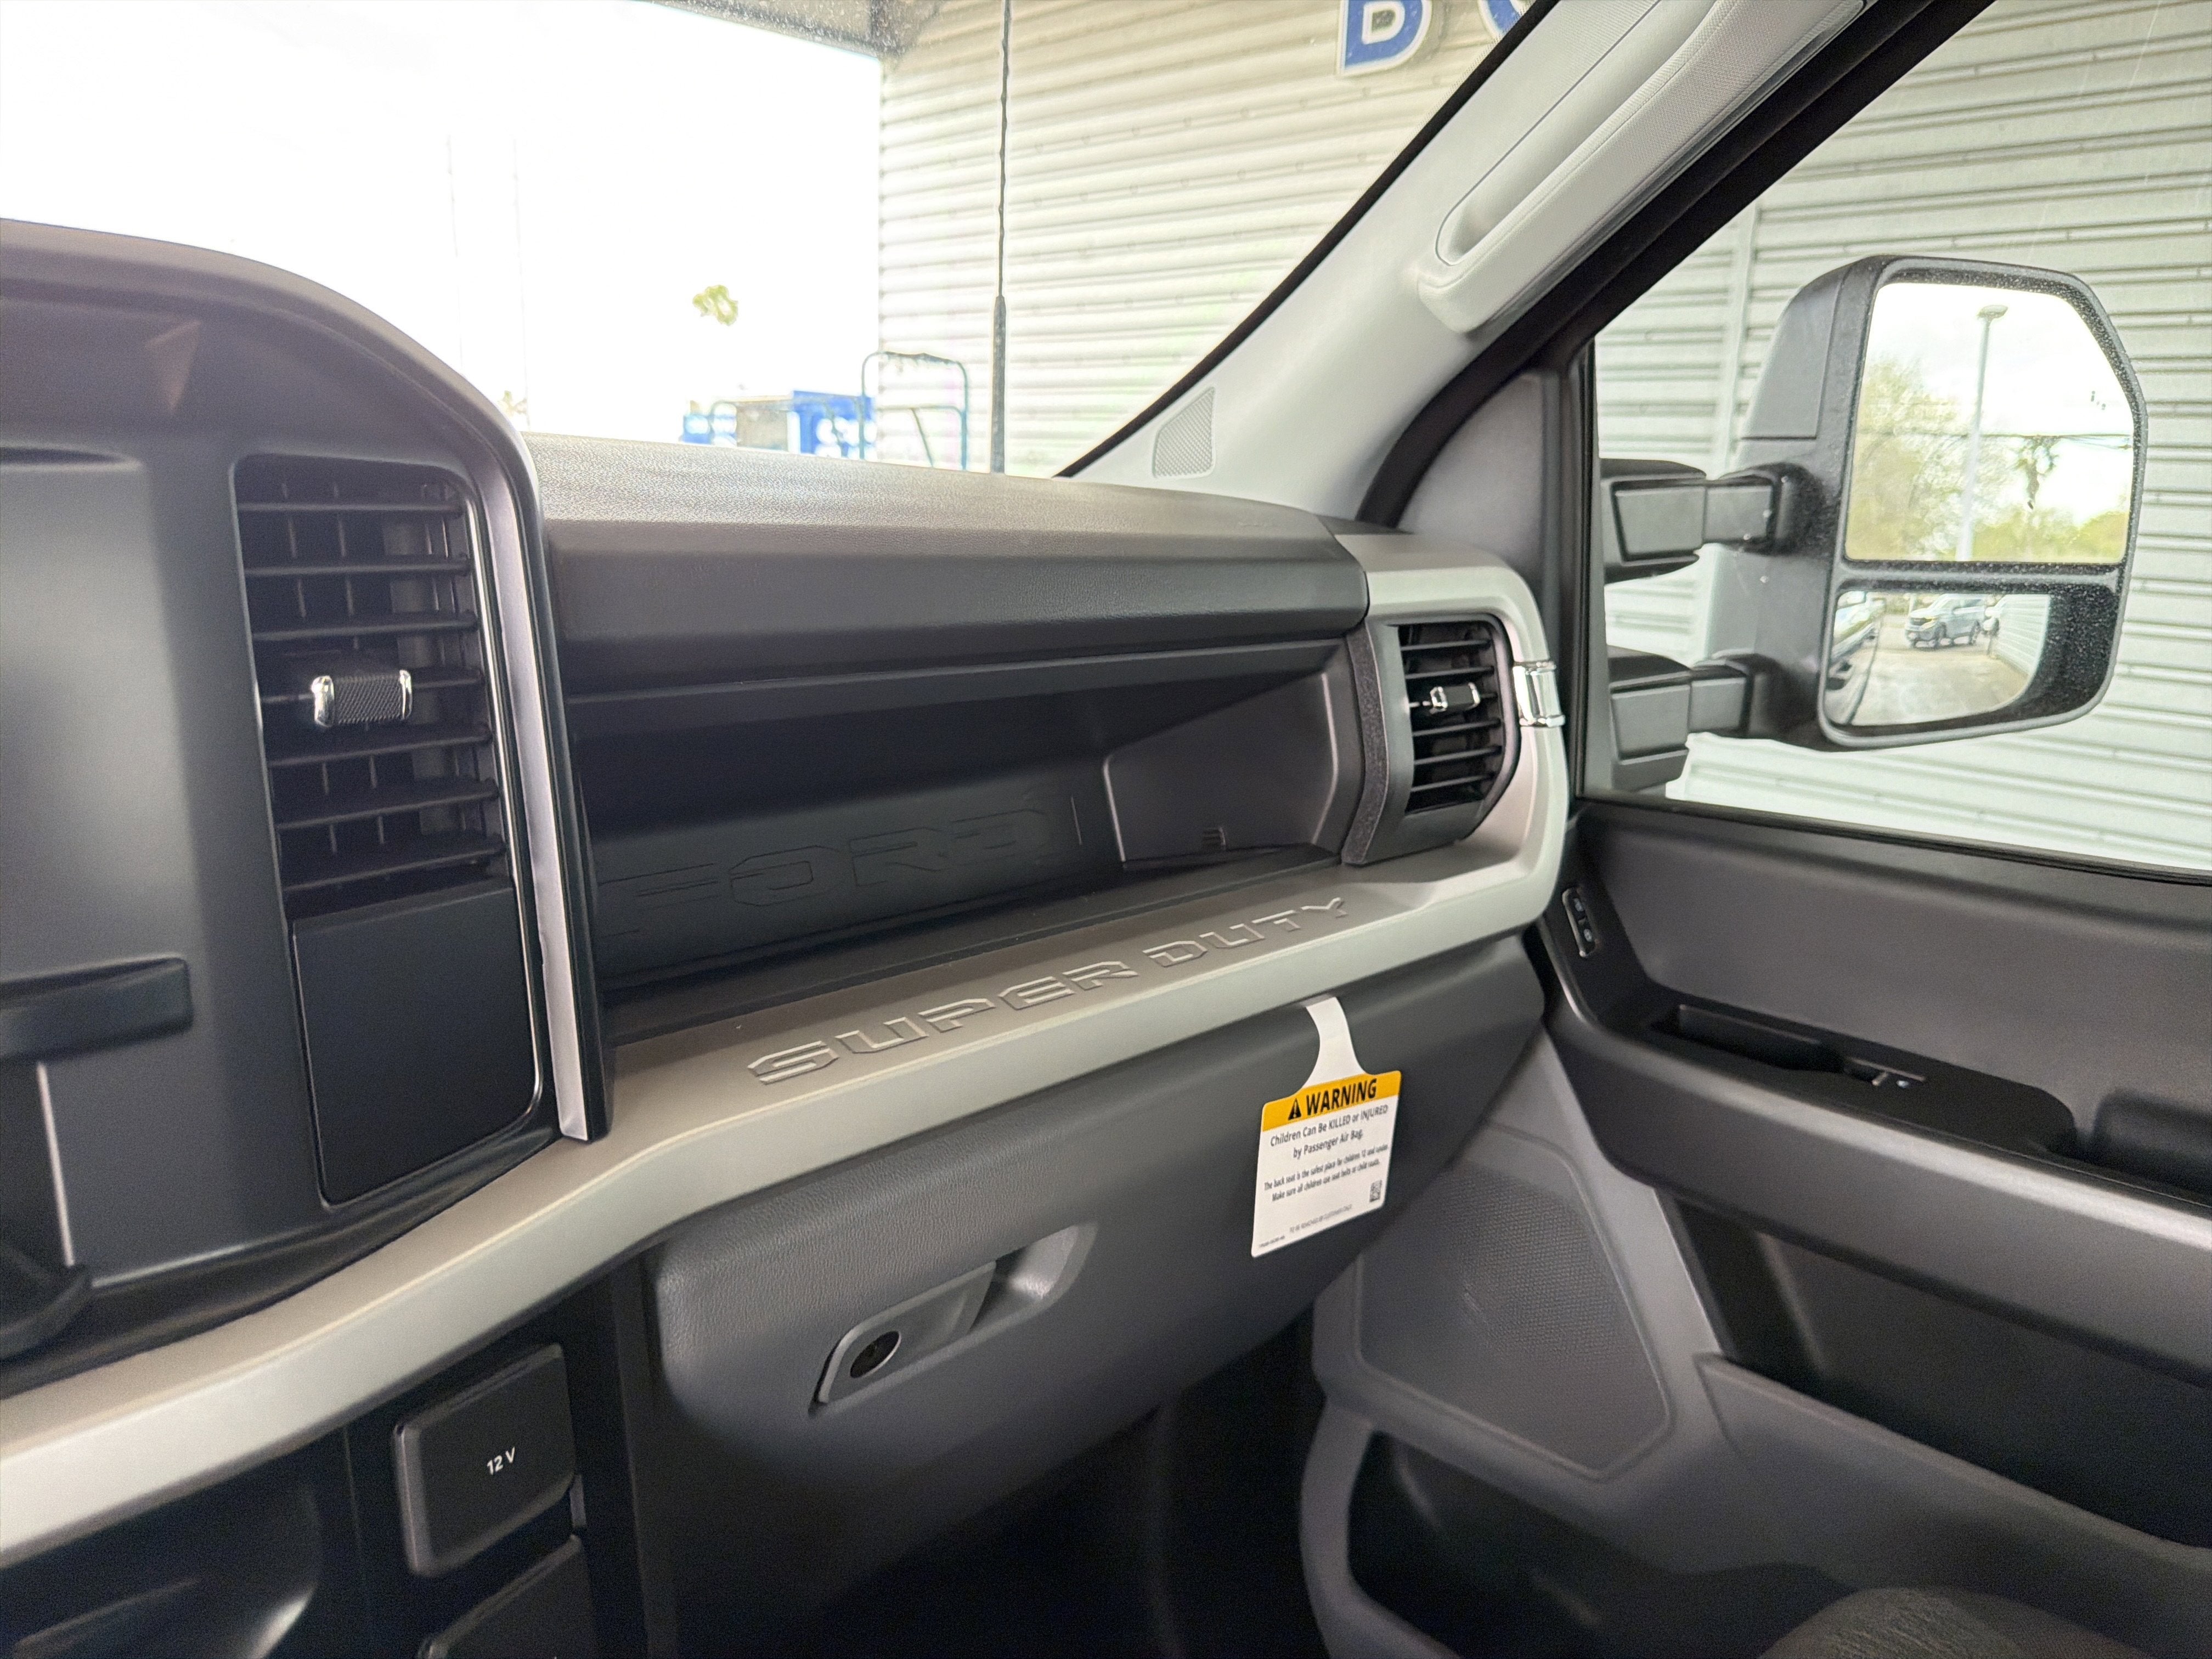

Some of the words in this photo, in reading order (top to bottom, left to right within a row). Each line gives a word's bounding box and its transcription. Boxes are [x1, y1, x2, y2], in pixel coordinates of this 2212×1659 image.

[747, 960, 1139, 1086] SUPER
[1142, 897, 1349, 968] DUTY
[1306, 1078, 1377, 1116] WARNING
[1271, 1130, 1301, 1147] Children
[1302, 1126, 1316, 1137] Can
[1318, 1122, 1327, 1133] Be
[1329, 1114, 1351, 1130] KILLED
[1352, 1113, 1359, 1122] or
[1361, 1104, 1389, 1121] INJURED
[1293, 1147, 1302, 1160] by
[1304, 1136, 1339, 1155] Passenger
[1339, 1132, 1349, 1143] Air
[487, 1455, 504, 1475] 12
[505, 1447, 515, 1463] V
